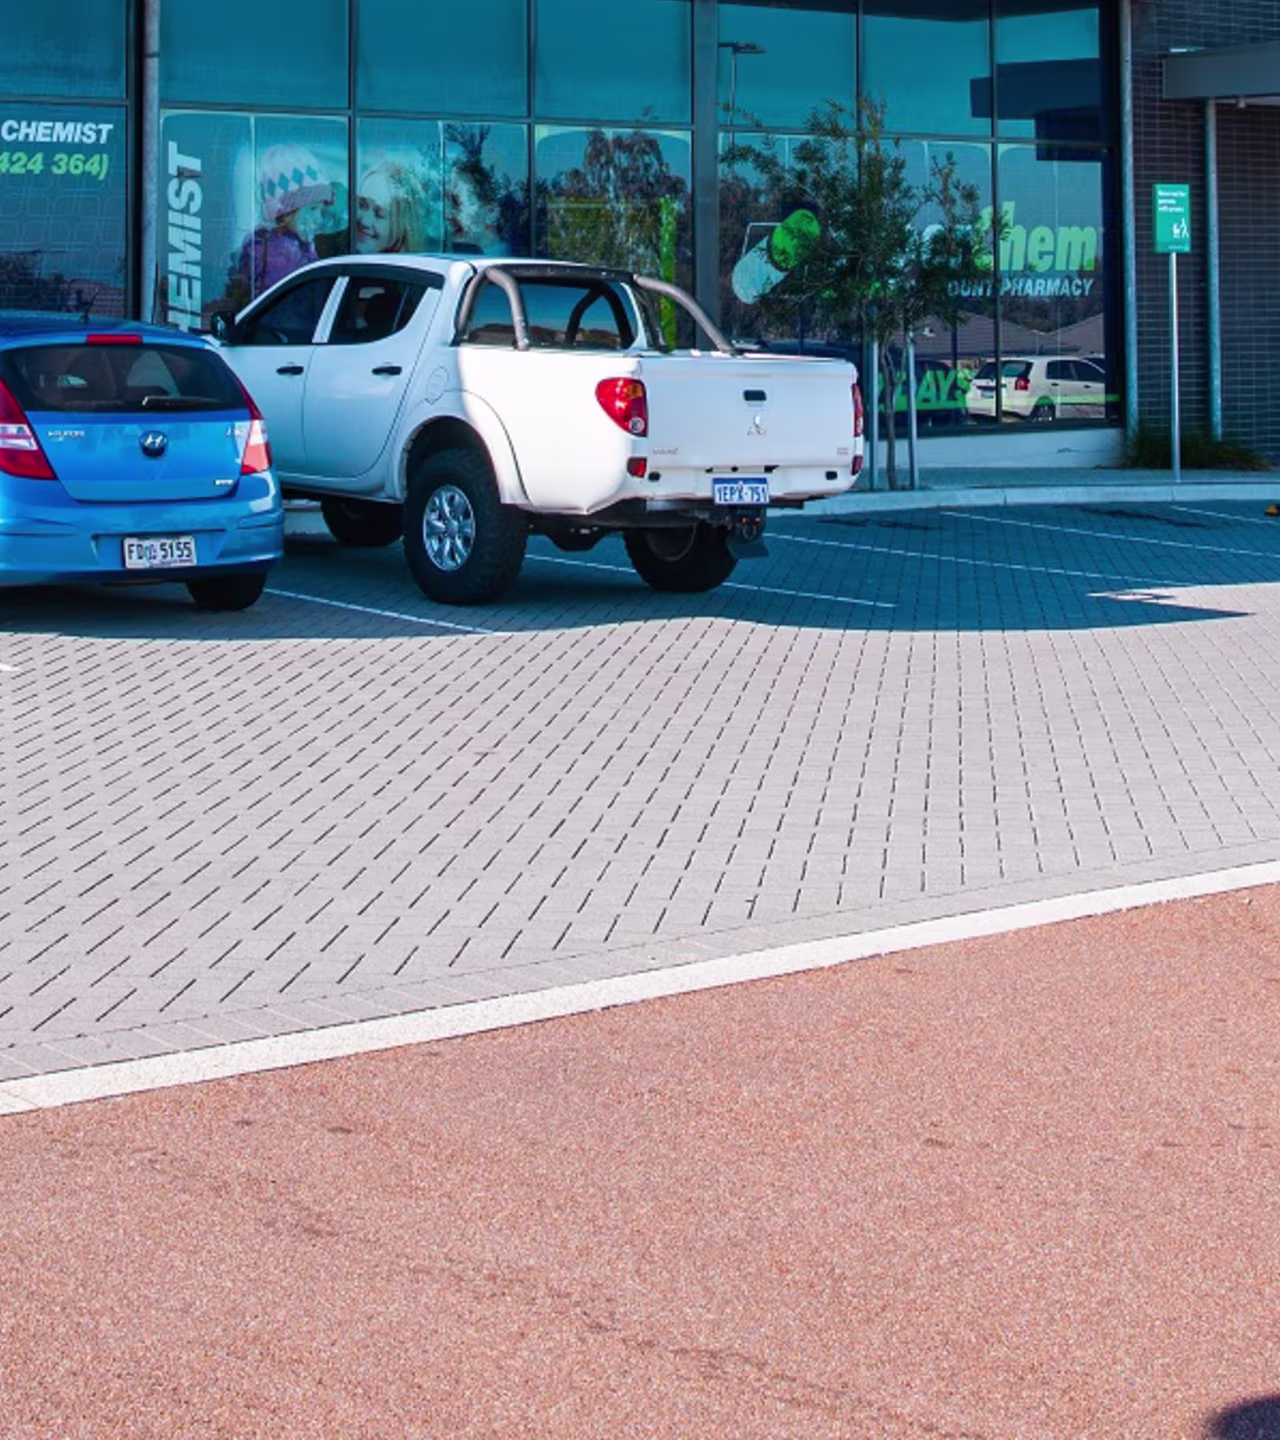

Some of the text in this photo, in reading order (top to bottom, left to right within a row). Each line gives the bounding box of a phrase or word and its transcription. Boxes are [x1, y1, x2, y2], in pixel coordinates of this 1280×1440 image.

[0, 119, 114, 144] CHEMIST
[51, 152, 109, 180] 364)
[1000, 277, 1095, 298] PHARMACY
[160, 541, 193, 559] 5155
